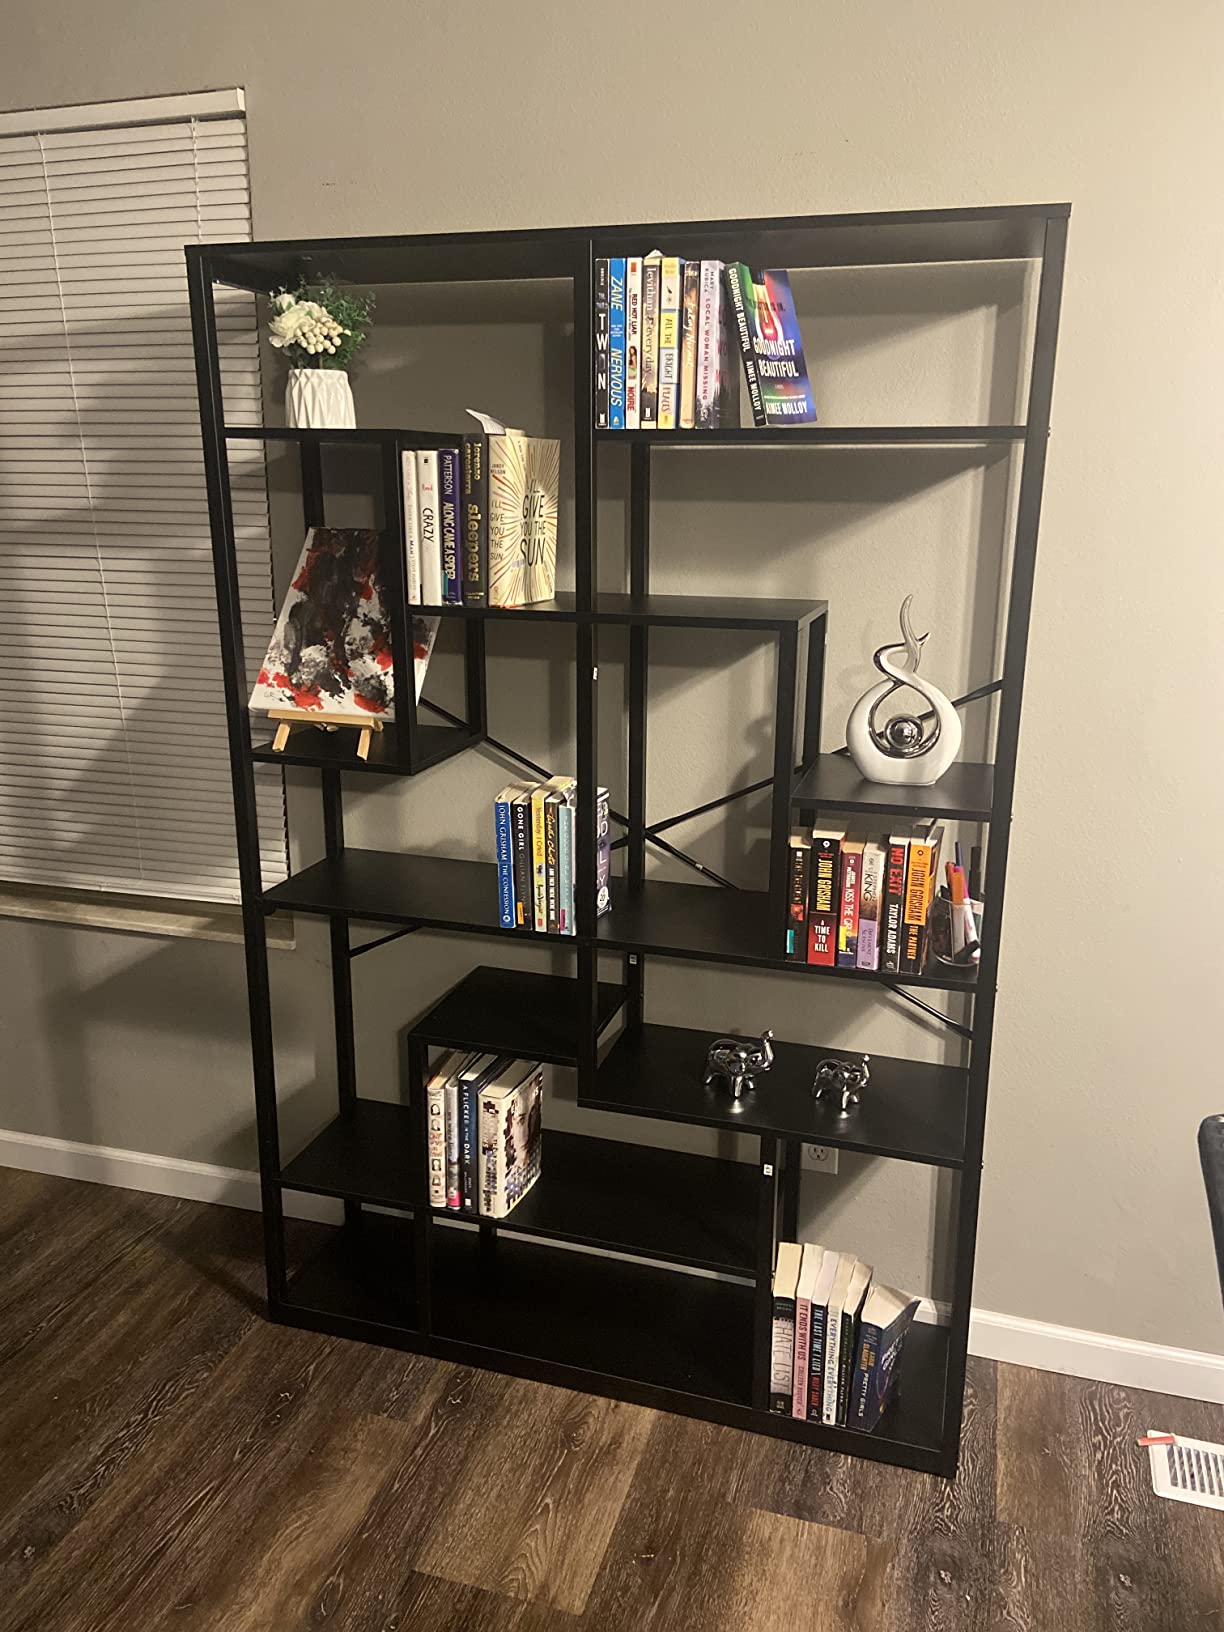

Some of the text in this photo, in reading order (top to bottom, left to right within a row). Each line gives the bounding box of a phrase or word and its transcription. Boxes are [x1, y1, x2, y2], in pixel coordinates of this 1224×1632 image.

[610, 276, 623, 311] ZANE
[646, 267, 657, 311] levithan
[664, 318, 673, 330] ALL
[728, 268, 762, 411] GOODNIGHT BEAUTIFUL AIMEE MOLLOY
[753, 336, 795, 356] GOODNIGHT
[644, 327, 656, 375] every day
[664, 352, 674, 379] BRIGHT
[758, 360, 799, 378] BEAUTIFUL
[610, 348, 623, 406] NERVOUS
[627, 386, 635, 412] NOIRE
[661, 386, 672, 412] PLACES
[766, 400, 808, 414] AIMEE MOLLOY
[442, 455, 453, 496] PATTERSON
[443, 502, 454, 527] ALONG
[522, 494, 545, 519] GIVE
[422, 507, 434, 542] CRAZY
[490, 513, 505, 522] GIVE
[520, 520, 546, 536] YOU THE
[444, 527, 455, 548] CAME
[490, 526, 505, 536] YOU
[467, 503, 482, 582] sleepers
[491, 540, 504, 548] THE
[520, 537, 545, 567] SUN
[490, 552, 503, 561] SUN
[498, 805, 506, 826] JOHN
[534, 806, 543, 834] Yesterday
[499, 826, 508, 861] GRISHAM
[818, 858, 833, 879] JOHN
[910, 868, 925, 888] JOHN
[816, 879, 832, 911] GRISHAM
[846, 888, 855, 902] KISS
[863, 873, 873, 902] KING
[844, 904, 854, 916] THE
[886, 847, 904, 954] NO EXIT TAYLOR ADAMS
[908, 888, 924, 922] GRISHAM
[814, 925, 830, 936] TIME
[818, 934, 826, 944] TO
[908, 926, 918, 935] THE
[814, 943, 828, 953] KILL
[907, 935, 917, 960] PARTNER
[798, 1312, 808, 1332] ENDS
[814, 1309, 823, 1320] THE
[813, 1322, 823, 1337] LAST
[774, 1326, 792, 1358] HATE
[798, 1332, 807, 1350] WITH
[812, 1338, 822, 1352] TIME
[797, 1350, 806, 1360] US
[811, 1358, 821, 1371] LIED
[825, 1318, 838, 1412] EVERYTHING EVERYTHING
[772, 1363, 790, 1392] LIST
[858, 1372, 869, 1417] PRETTY GIRLS
